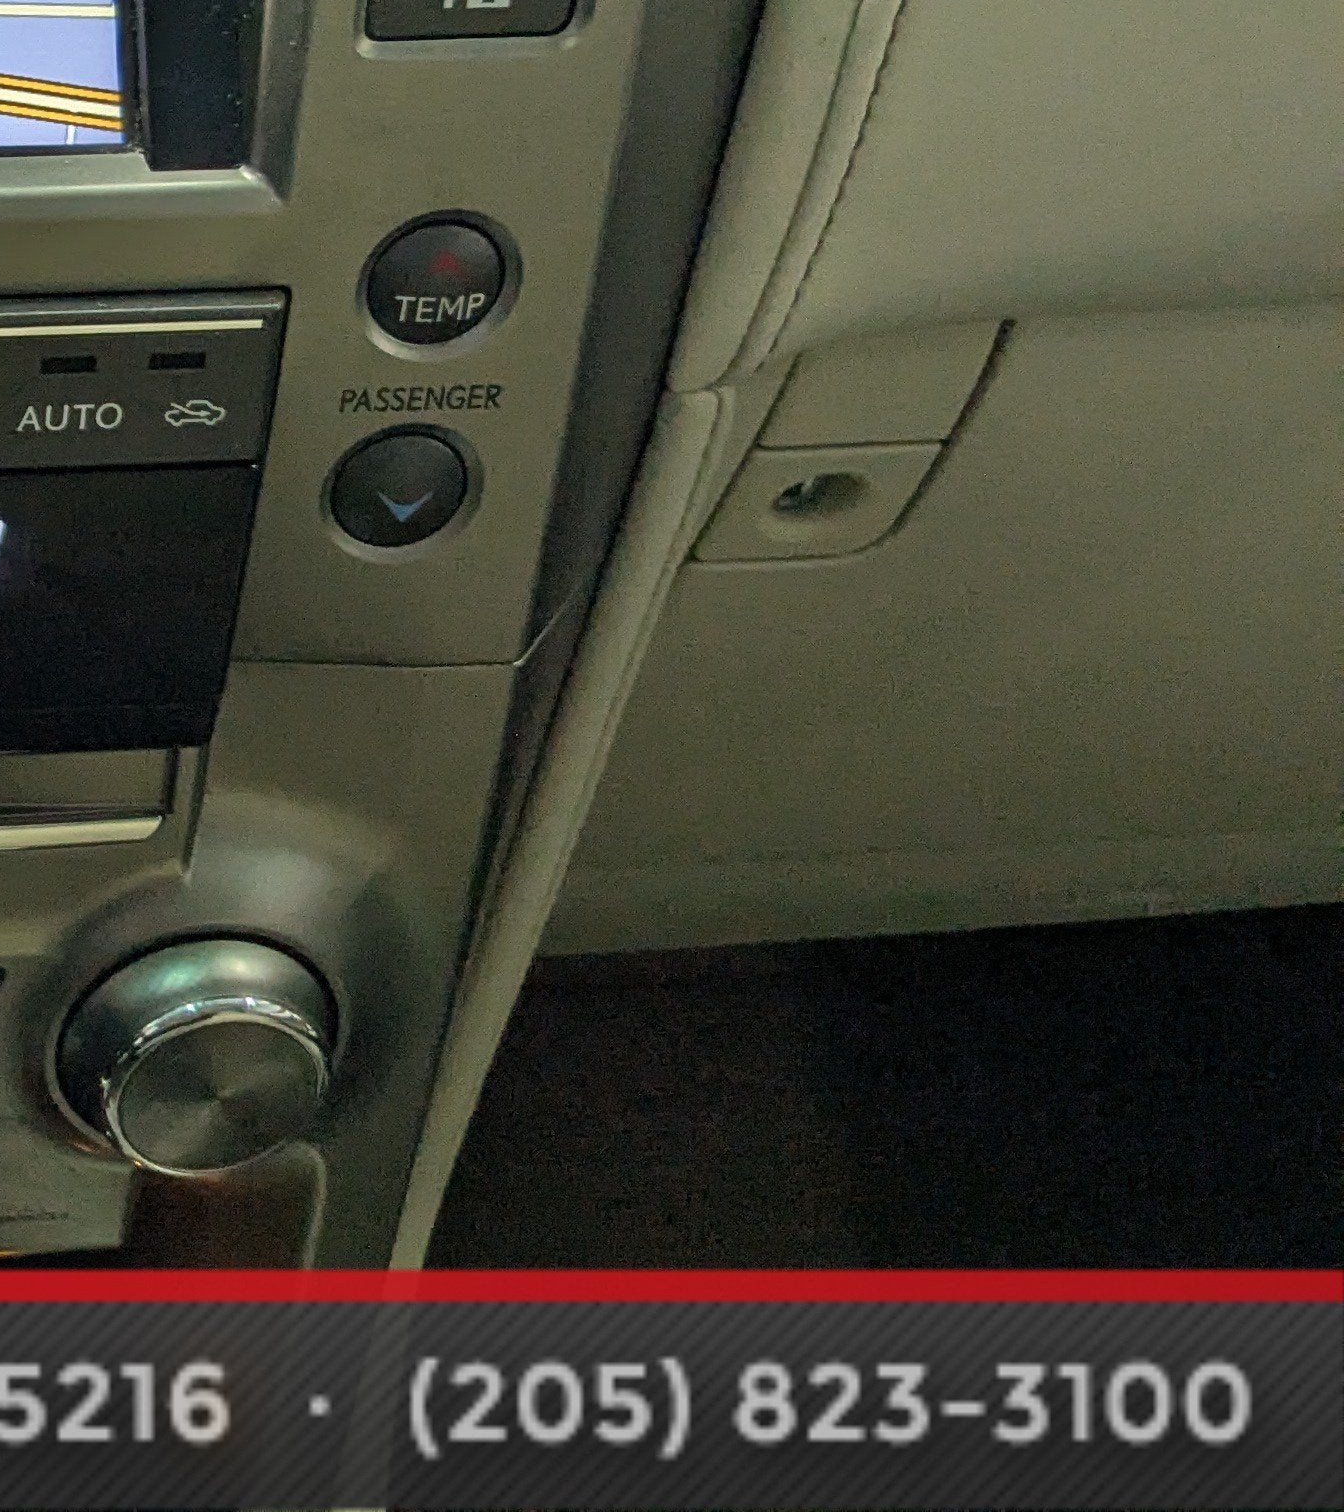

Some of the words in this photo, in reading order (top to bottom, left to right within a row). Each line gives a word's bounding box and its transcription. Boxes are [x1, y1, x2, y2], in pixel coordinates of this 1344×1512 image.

[395, 292, 486, 323] TEMP
[339, 384, 502, 413] PASSENGER
[16, 402, 125, 434] AUTO
